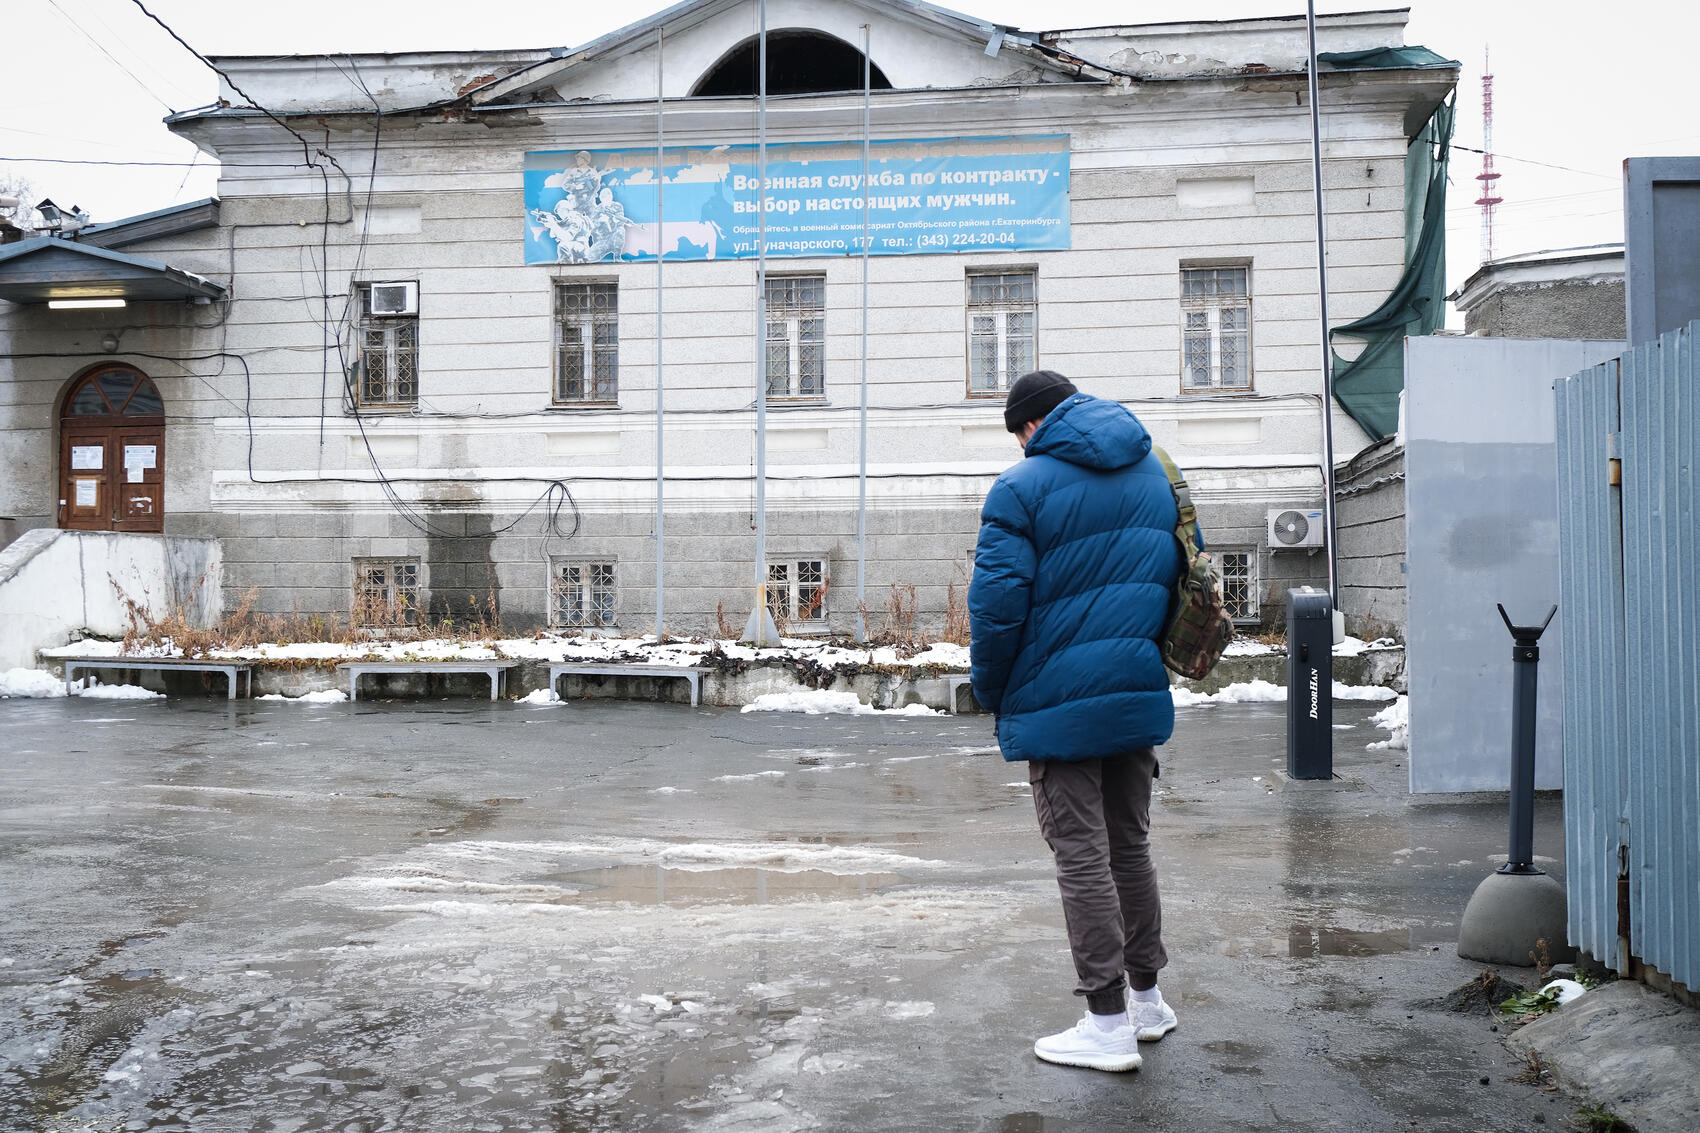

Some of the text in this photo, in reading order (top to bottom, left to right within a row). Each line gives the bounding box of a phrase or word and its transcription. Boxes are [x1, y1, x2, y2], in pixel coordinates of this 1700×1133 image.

[733, 174, 822, 190] Военная
[827, 170, 905, 190] служба
[910, 173, 936, 185] по
[941, 168, 1049, 186] контракту
[733, 193, 1016, 215] выбор настоящих мужчин.
[733, 224, 790, 235] Обращйтесь
[800, 223, 838, 232] военный
[897, 219, 956, 229] Октябрьского
[958, 218, 990, 228] района
[852, 236, 874, 248] 177
[881, 237, 913, 247] тел.:
[917, 234, 948, 249] (343)
[952, 232, 1015, 245] 224-20-04
